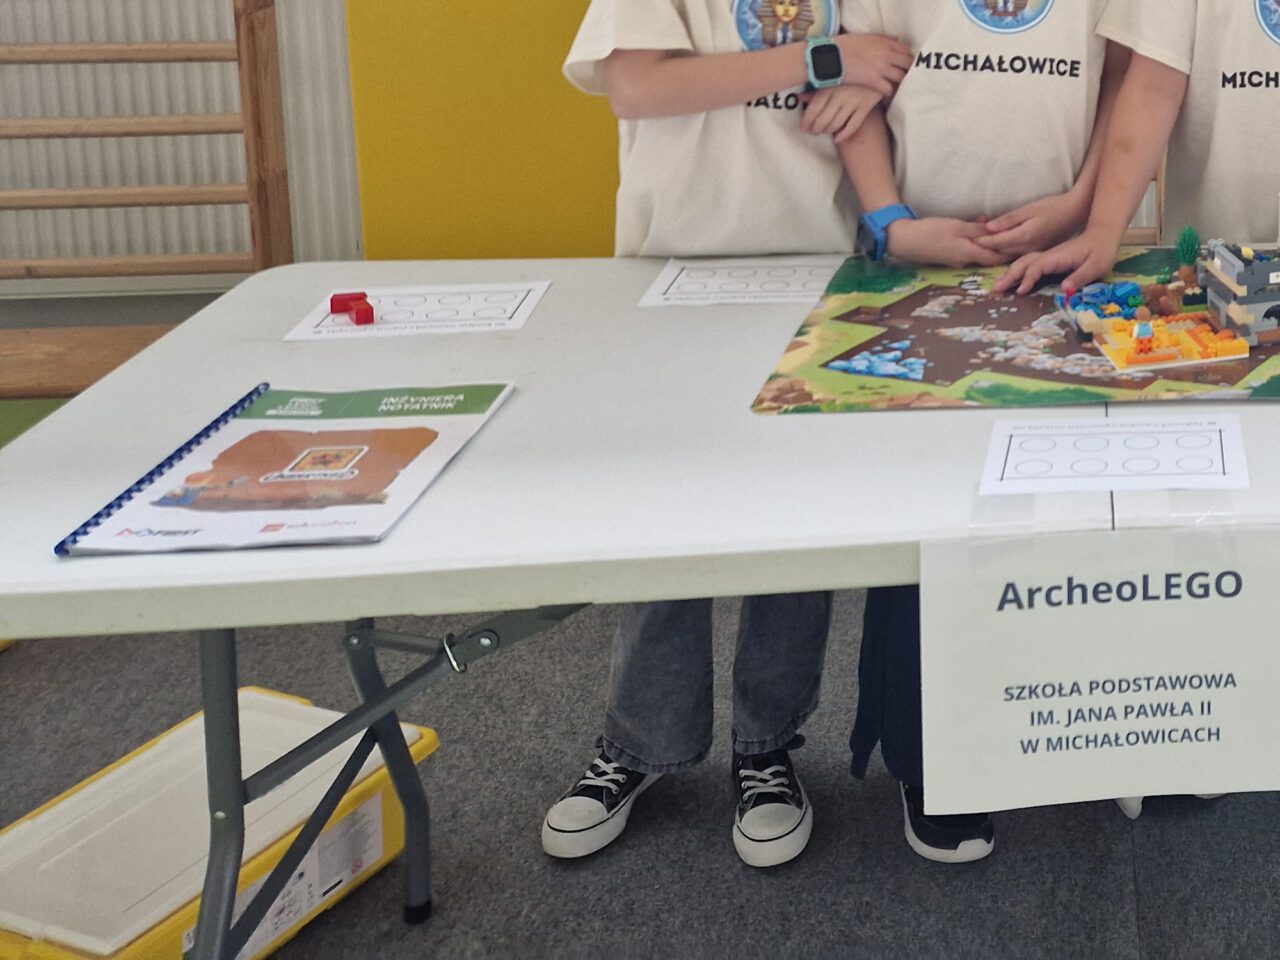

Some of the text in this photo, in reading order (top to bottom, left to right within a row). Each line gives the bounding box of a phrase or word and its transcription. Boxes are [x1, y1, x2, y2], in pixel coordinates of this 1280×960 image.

[915, 50, 1082, 79] MICHAŁOWICE
[997, 570, 1244, 612] ArcheoLEGO
[1003, 673, 1237, 702] SZKOŁA PODSTAWOWA
[1030, 700, 1212, 728] IM. JANA PAWŁA II
[1020, 727, 1221, 755] W MICHAŁOWICACH
